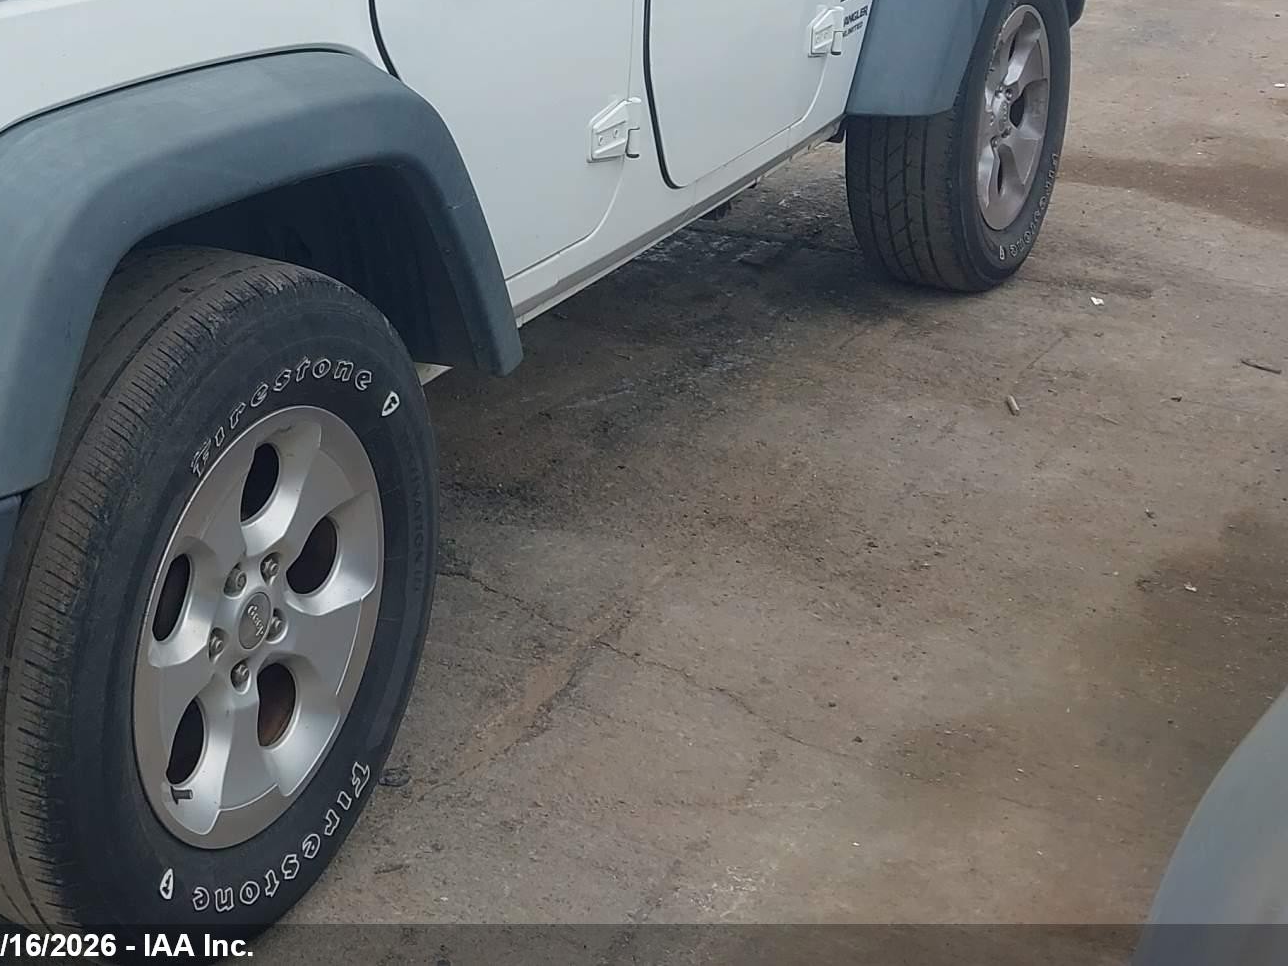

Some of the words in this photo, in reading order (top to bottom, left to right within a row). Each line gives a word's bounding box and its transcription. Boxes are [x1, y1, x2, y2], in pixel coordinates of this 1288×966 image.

[190, 355, 372, 478] Firestone
[247, 605, 265, 637] Jeep
[192, 761, 371, 912] Firestone
